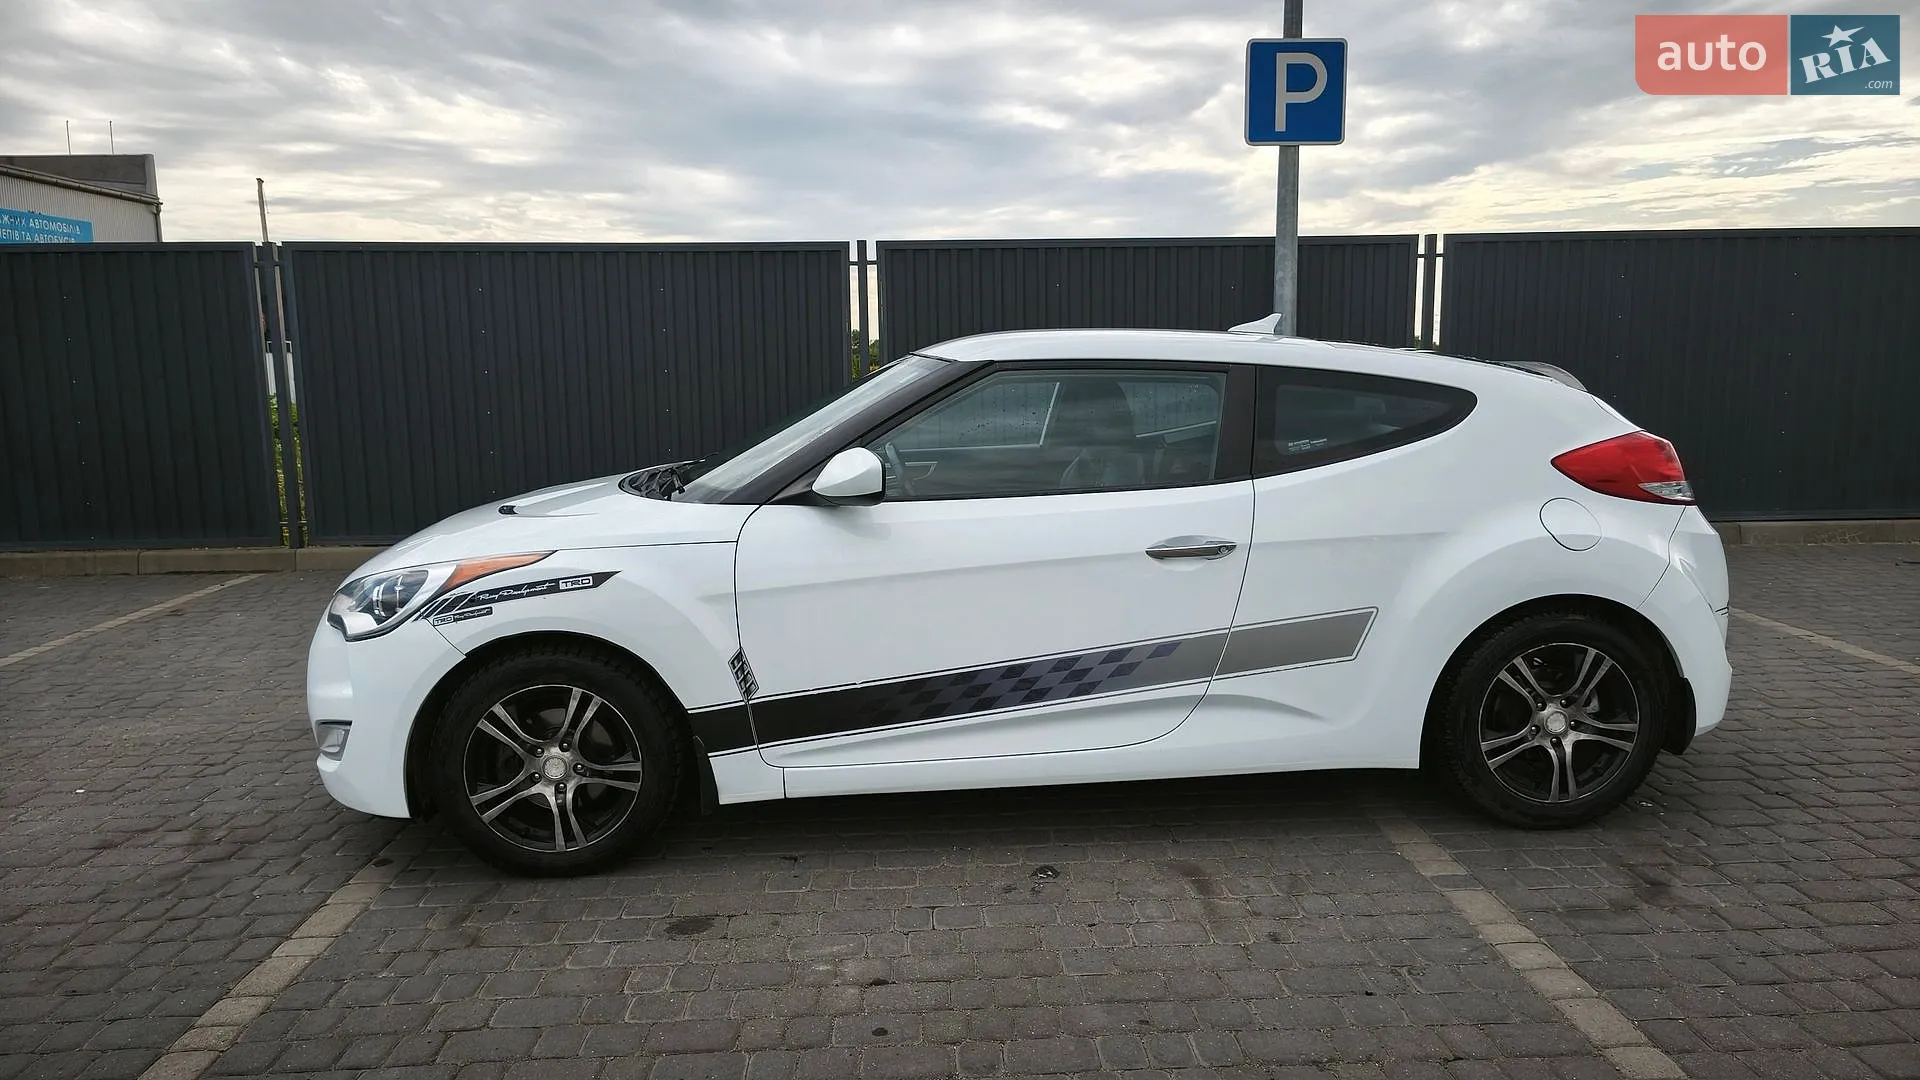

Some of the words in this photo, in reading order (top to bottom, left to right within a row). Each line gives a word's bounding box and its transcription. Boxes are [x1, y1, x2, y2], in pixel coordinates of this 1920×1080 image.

[1275, 52, 1328, 132] P
[0, 214, 26, 228] ЖНИХ
[29, 218, 81, 235] АВТОМОБІЛІВ
[22, 231, 31, 241] ТА
[561, 578, 591, 588] TRD
